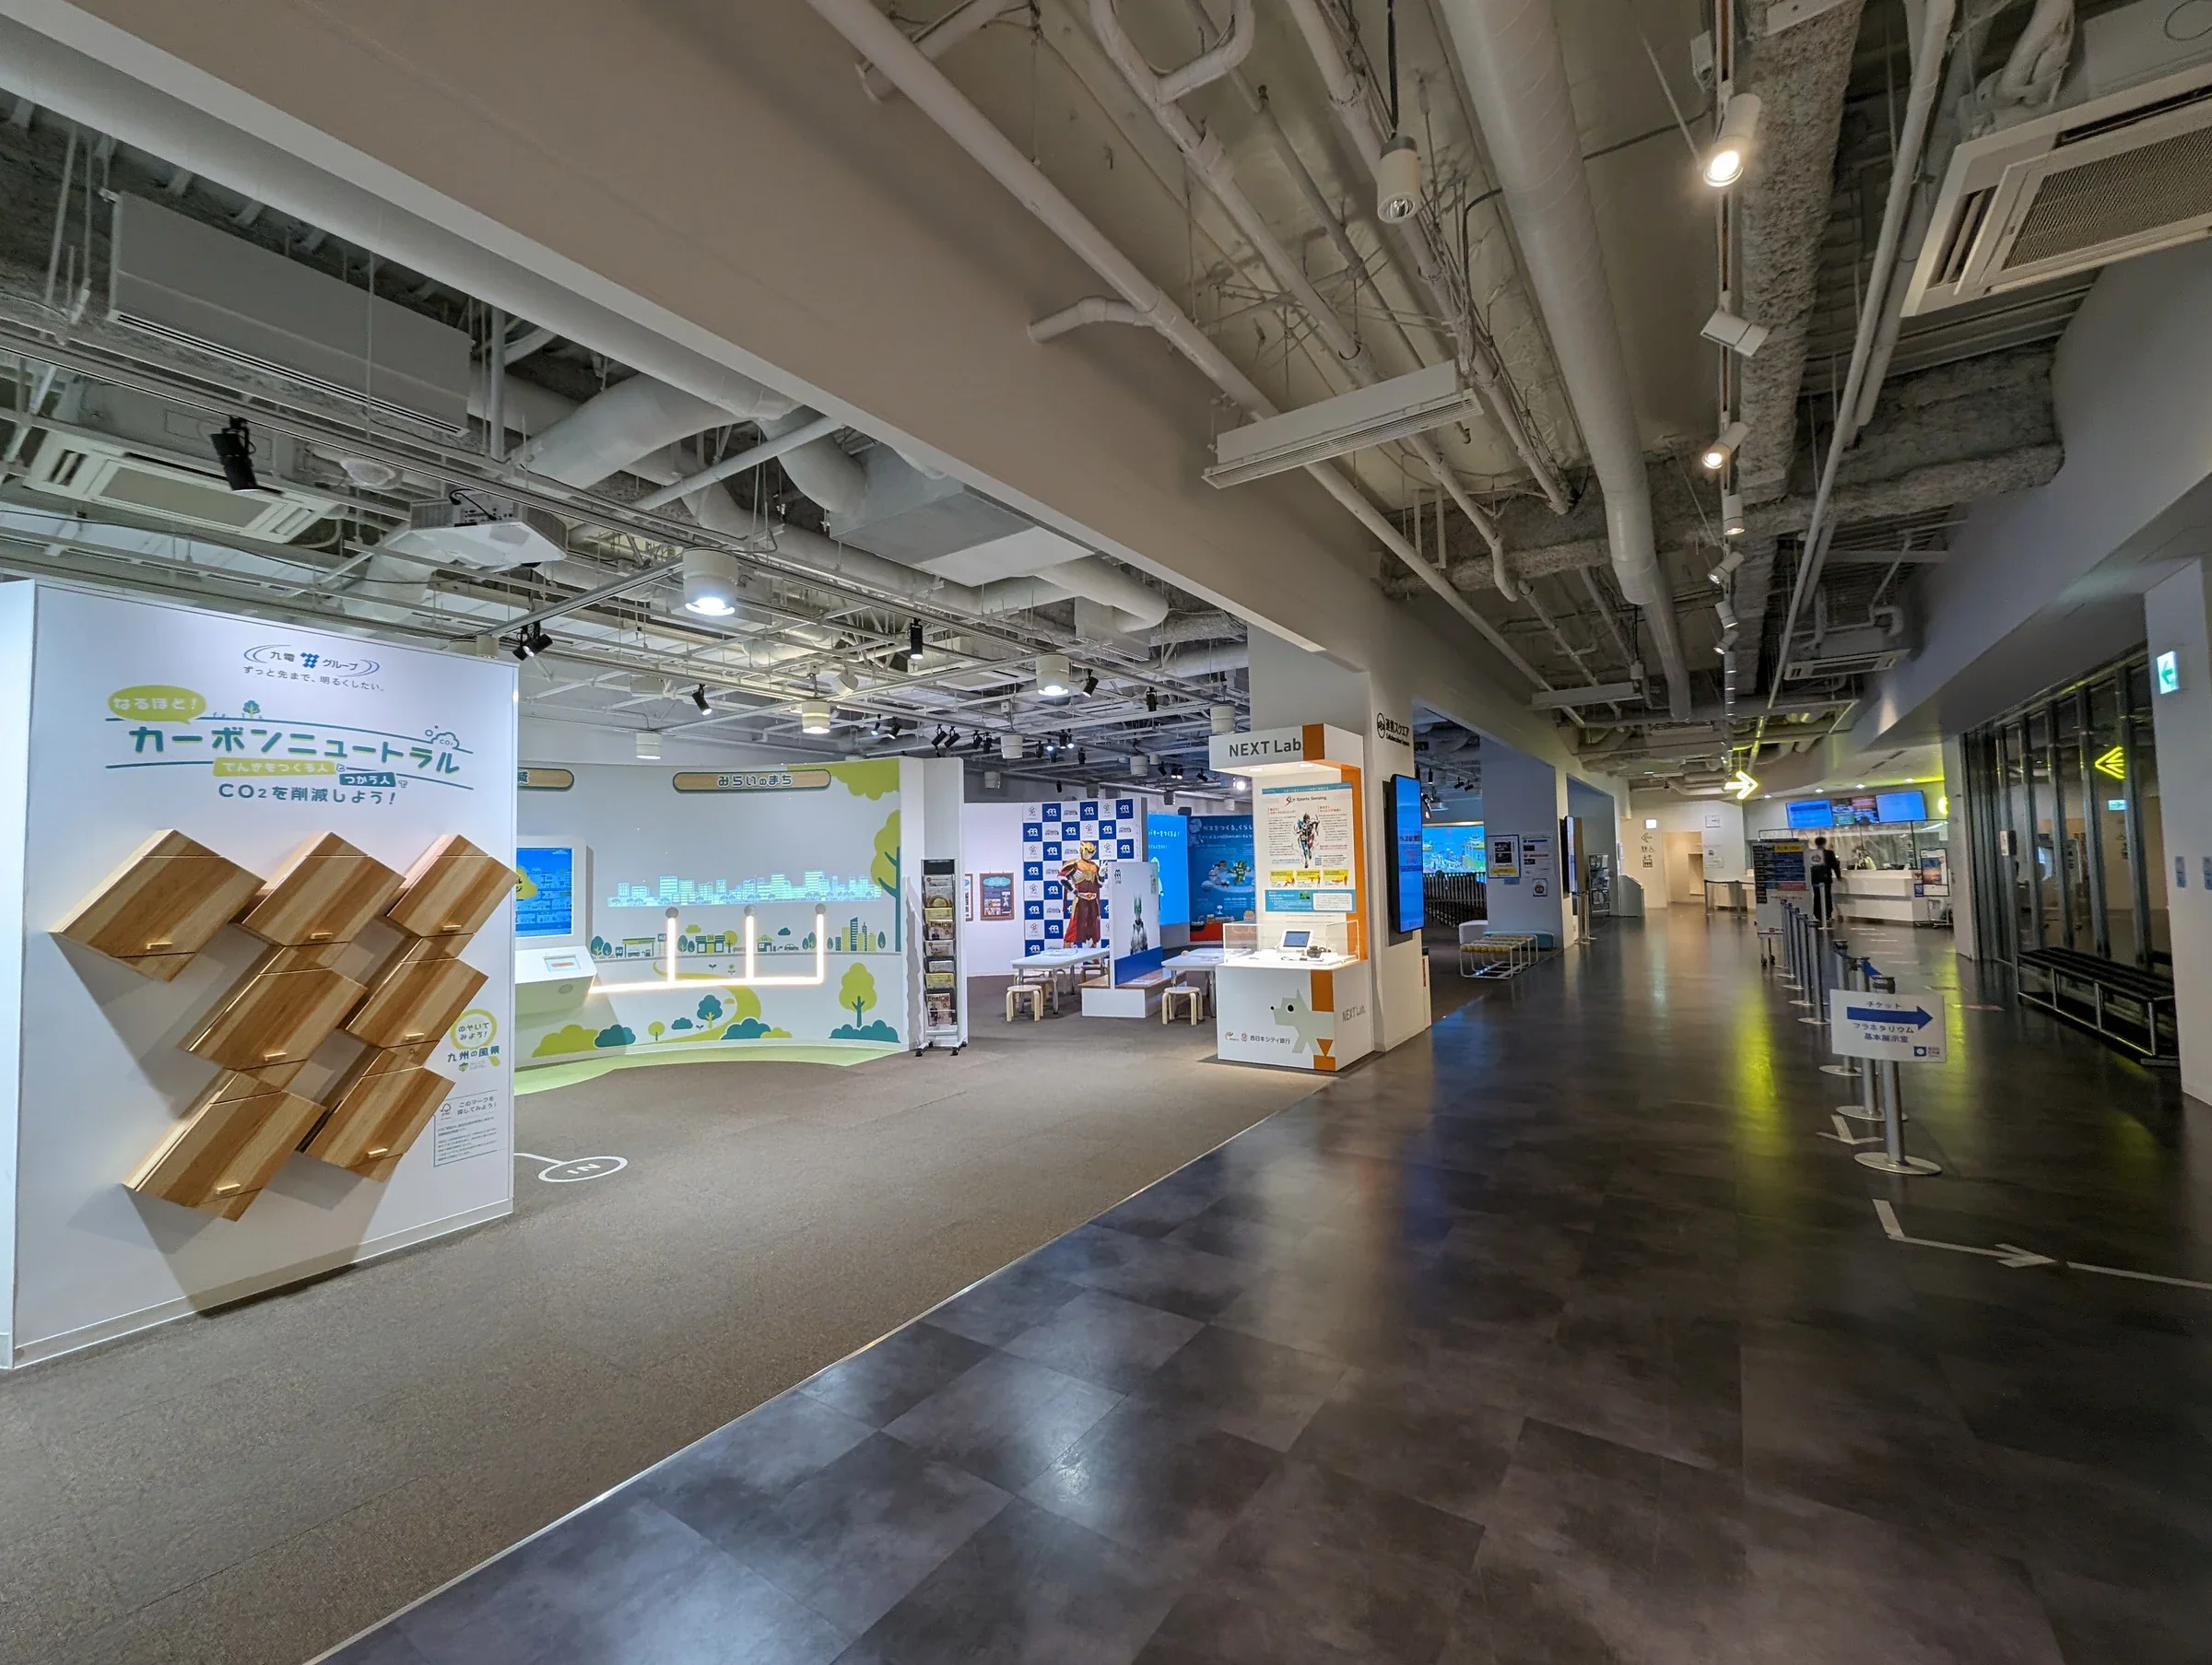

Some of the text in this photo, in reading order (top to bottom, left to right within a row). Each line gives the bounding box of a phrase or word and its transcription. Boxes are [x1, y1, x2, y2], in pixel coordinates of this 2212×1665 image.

[270, 651, 359, 671] 九電 グループ
[243, 666, 384, 692] ずっと先まで、明るくしたい。
[129, 726, 460, 775] カーボンニュートラル
[1229, 740, 1270, 757] NEXT
[344, 775, 391, 785] つかう人
[718, 774, 793, 787] みらいのまち
[1866, 1001, 1901, 1009] チケット
[1250, 1035, 1290, 1045] 西日本シティ銀行
[447, 1046, 500, 1062] 九州の風景
[459, 1096, 494, 1108] このマークを
